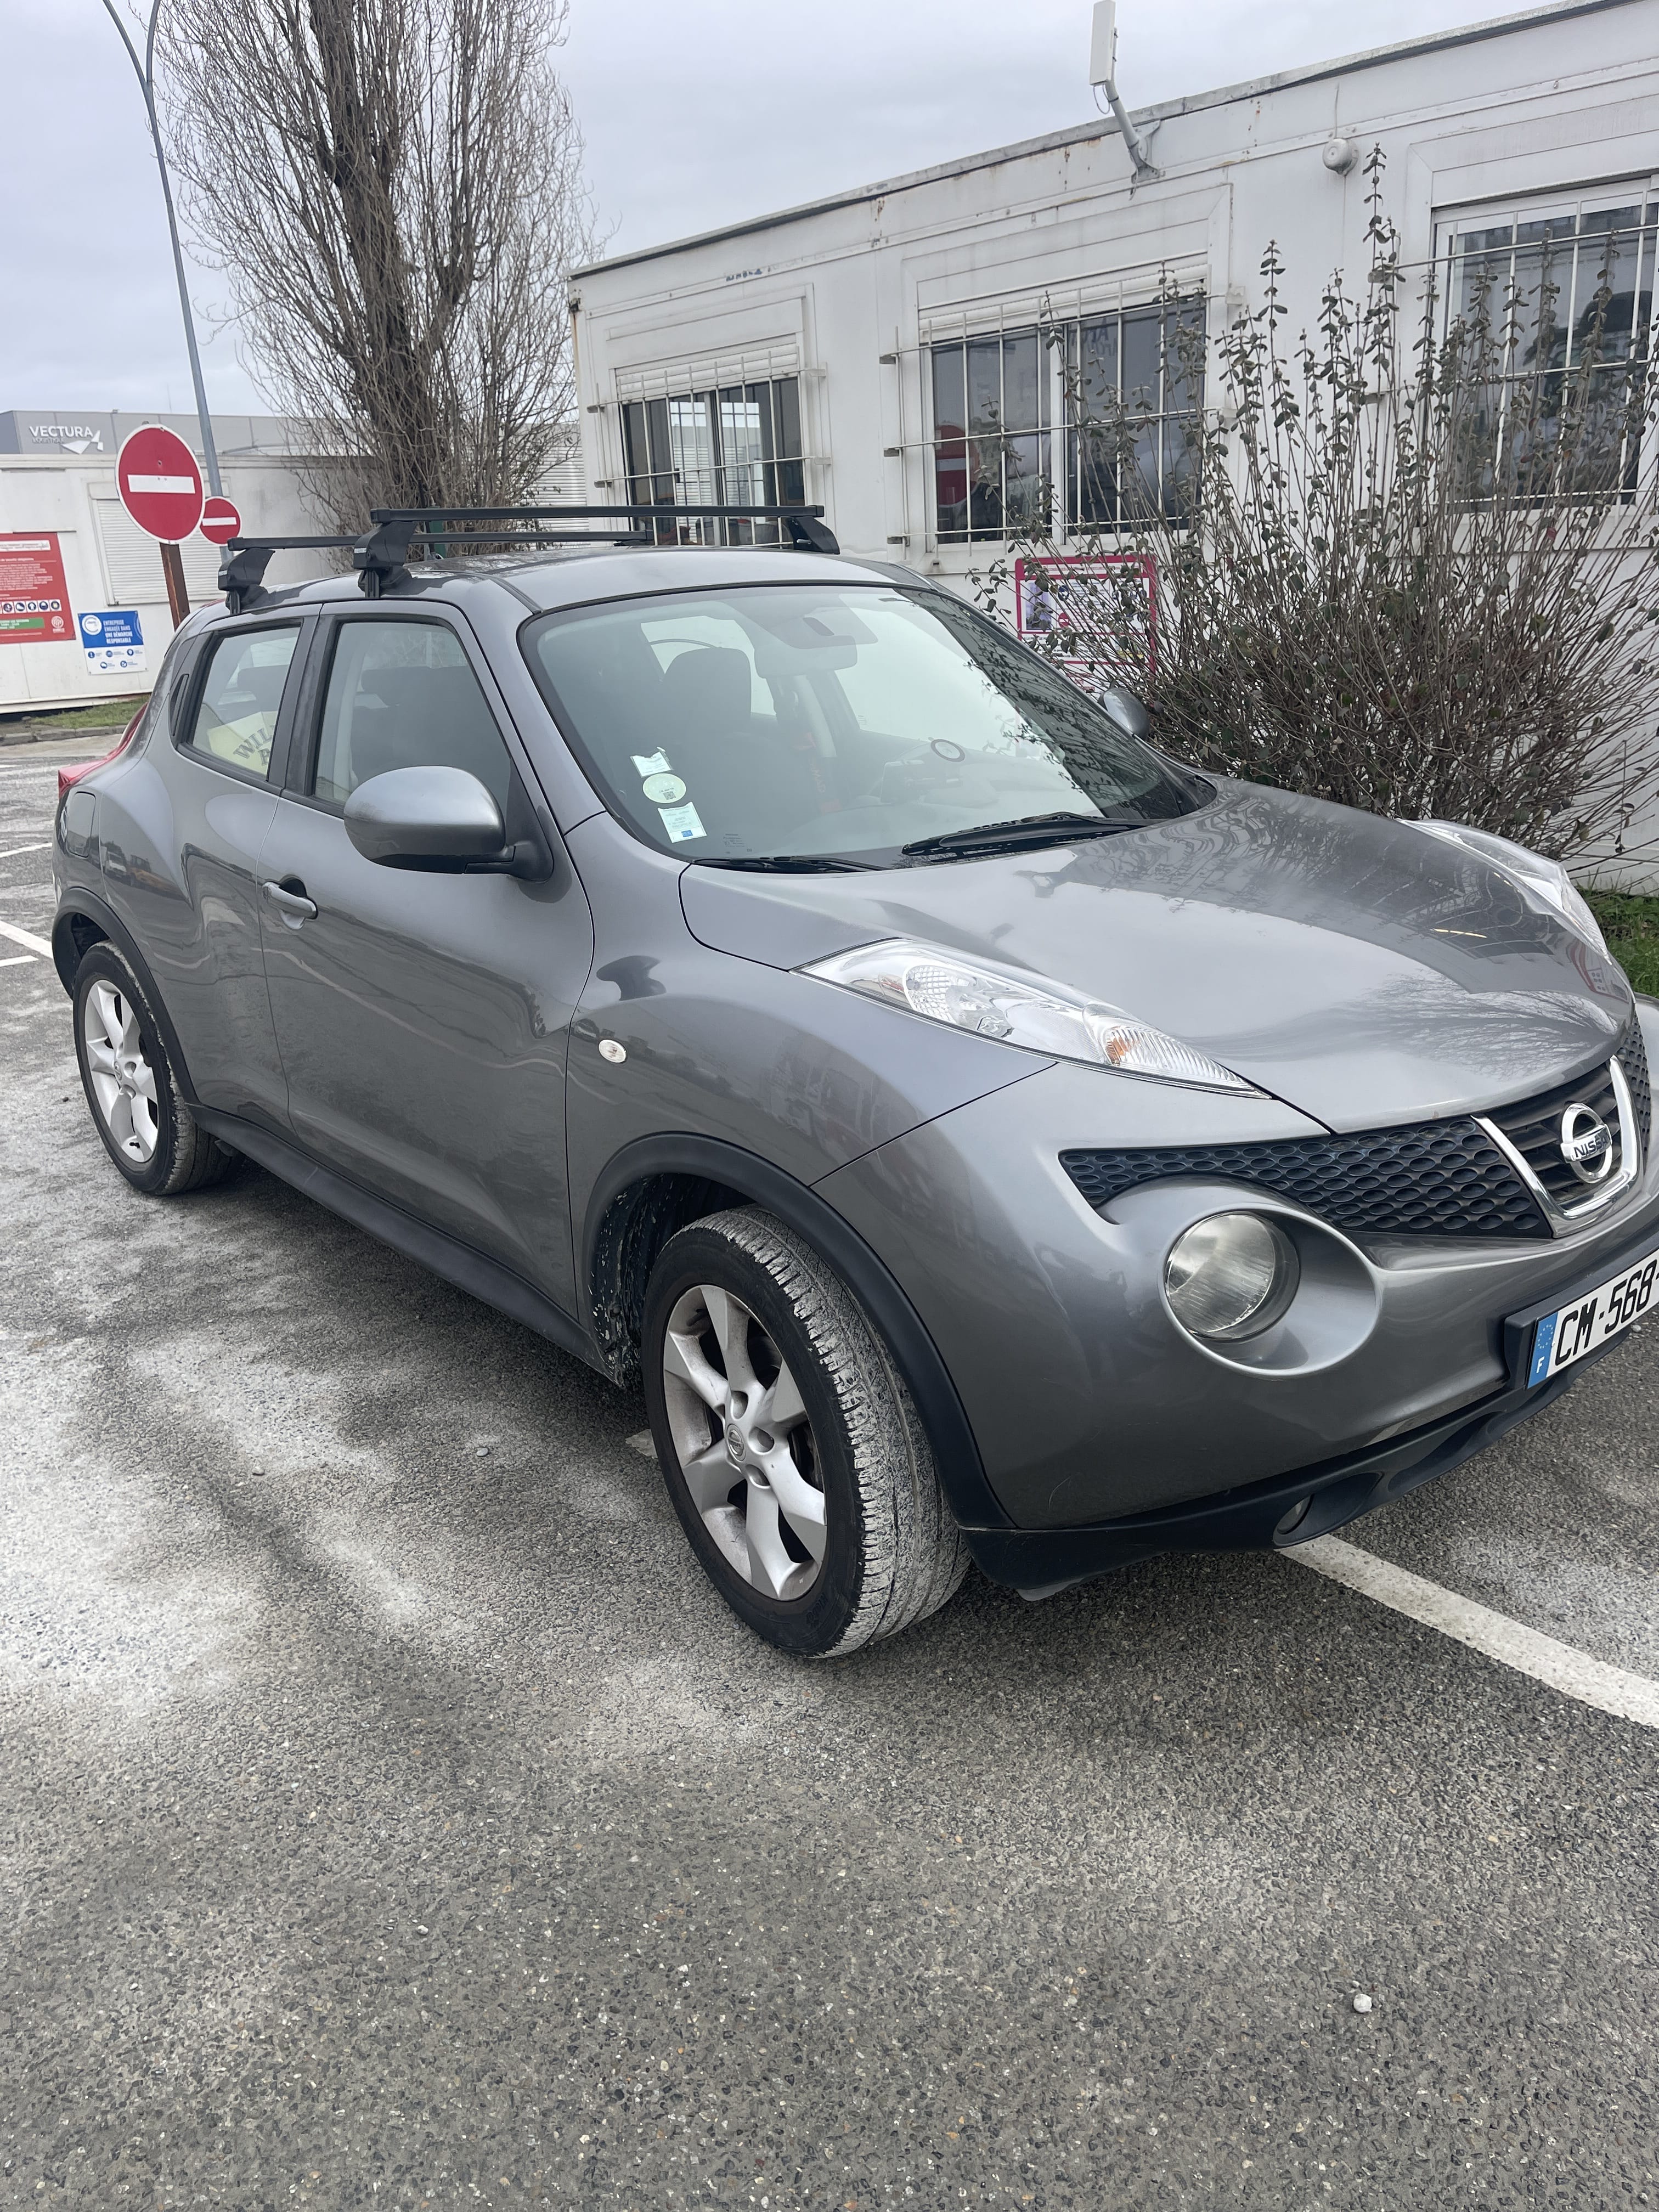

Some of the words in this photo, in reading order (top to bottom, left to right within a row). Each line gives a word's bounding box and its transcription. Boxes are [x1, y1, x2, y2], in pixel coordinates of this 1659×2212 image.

[29, 426, 93, 438] VECTURA
[1573, 1136, 1609, 1158] NISSA
[1536, 1356, 1545, 1374] F
